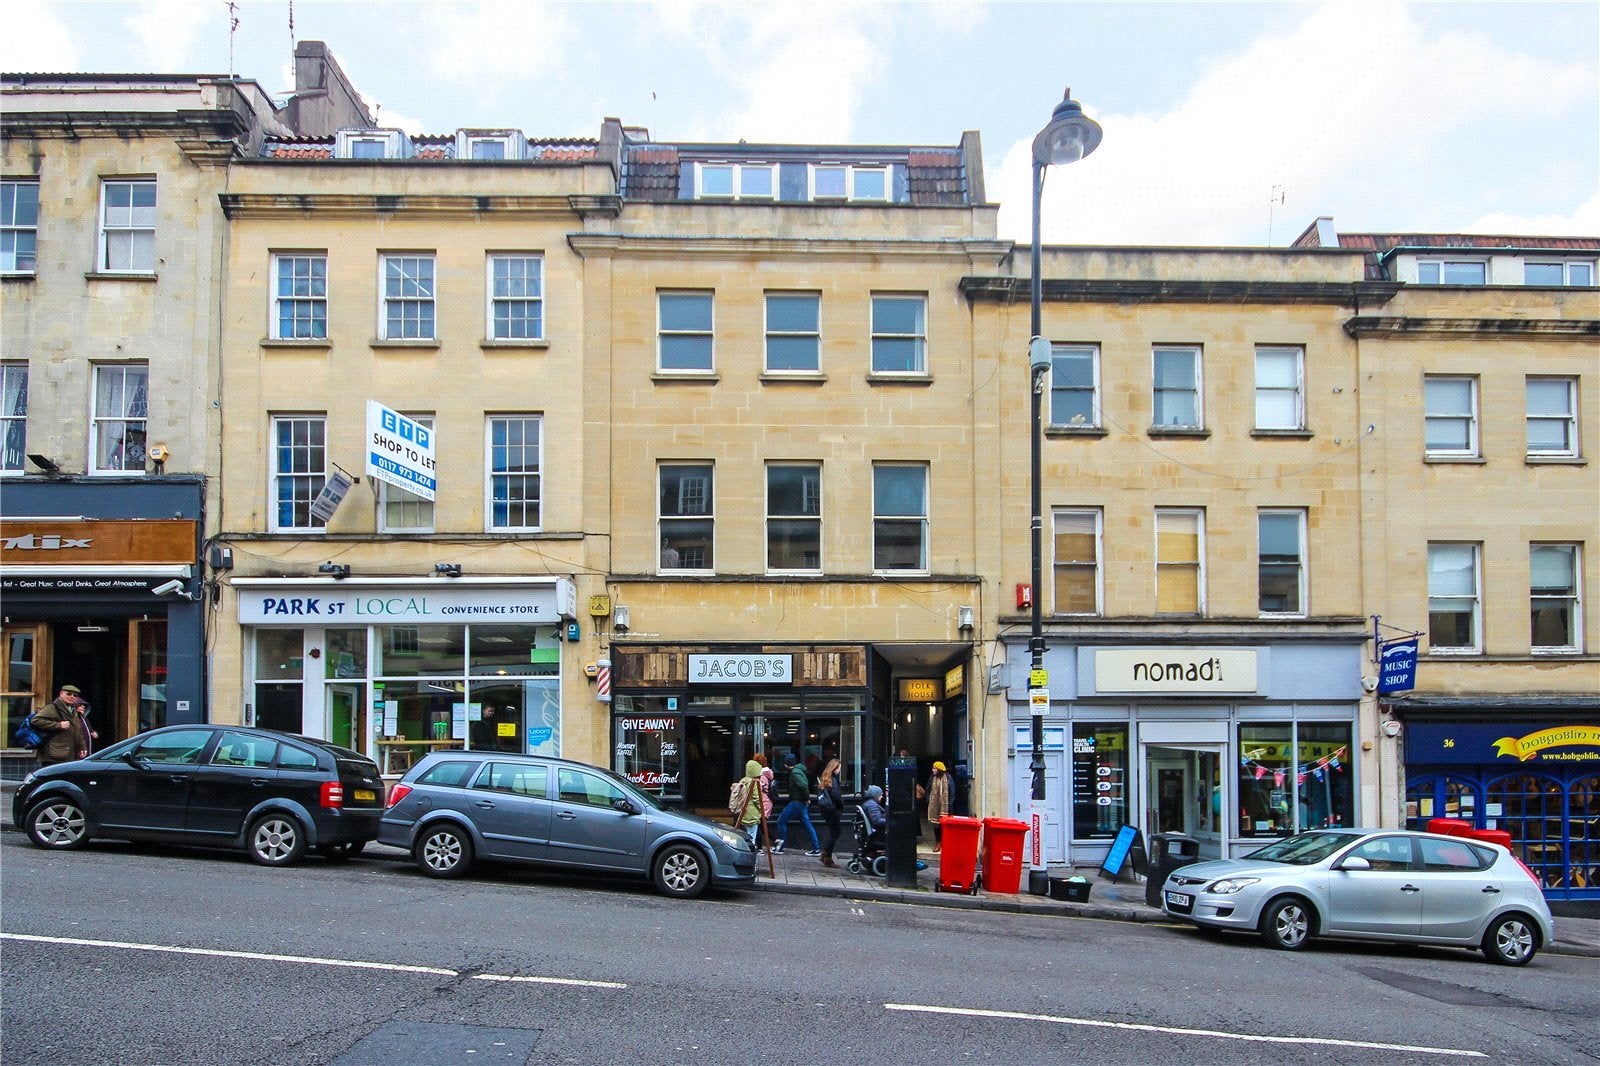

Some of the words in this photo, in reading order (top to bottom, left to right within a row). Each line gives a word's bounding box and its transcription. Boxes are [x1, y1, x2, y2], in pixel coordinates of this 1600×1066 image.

[385, 413, 427, 443] ETP
[374, 433, 402, 454] SHOP
[405, 447, 418, 462] TO
[421, 455, 436, 471] LET
[378, 457, 396, 472] 0117
[399, 466, 412, 478] 973
[415, 473, 431, 487] 1474
[20, 580, 37, 588] Great
[57, 580, 74, 588] Great
[95, 580, 111, 588] Great
[113, 580, 147, 588] Atmosphere
[263, 598, 320, 615] PARK
[328, 602, 345, 614] ST
[356, 598, 433, 615] LOCAL
[441, 605, 506, 614] CONVENIENCE
[509, 605, 540, 614] STORE
[697, 659, 785, 678] JACOB'S
[1384, 660, 1412, 672] MUSIC
[1385, 674, 1408, 685] SHOP
[621, 718, 675, 730] GIVEAWAY!
[1443, 739, 1455, 748] 36
[644, 771, 680, 785] Instore!
